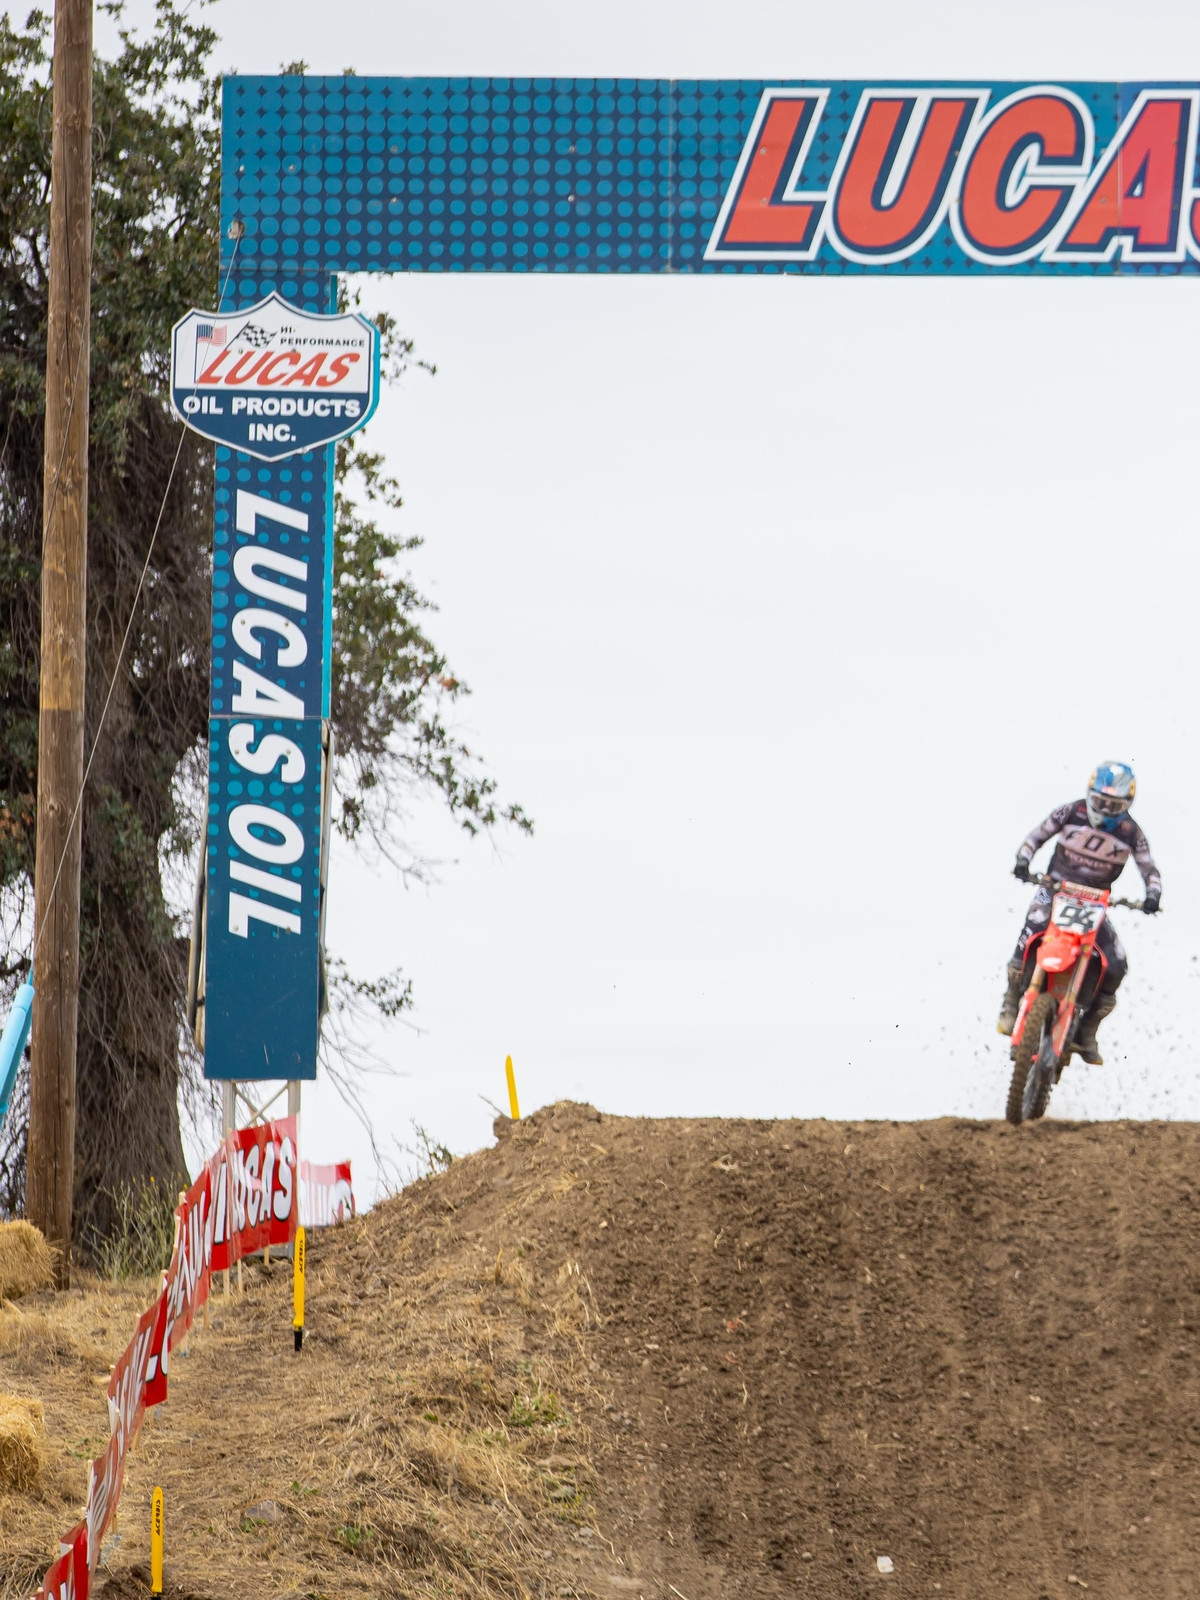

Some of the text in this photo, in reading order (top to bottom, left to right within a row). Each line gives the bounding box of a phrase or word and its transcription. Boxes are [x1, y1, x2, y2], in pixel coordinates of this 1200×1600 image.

[280, 338, 365, 347] PERFORMANCE
[196, 350, 361, 387] LUCAS
[183, 396, 361, 418] OIL PRODUCTS
[248, 423, 297, 442] INC.
[227, 488, 309, 939] LUCAS OIL
